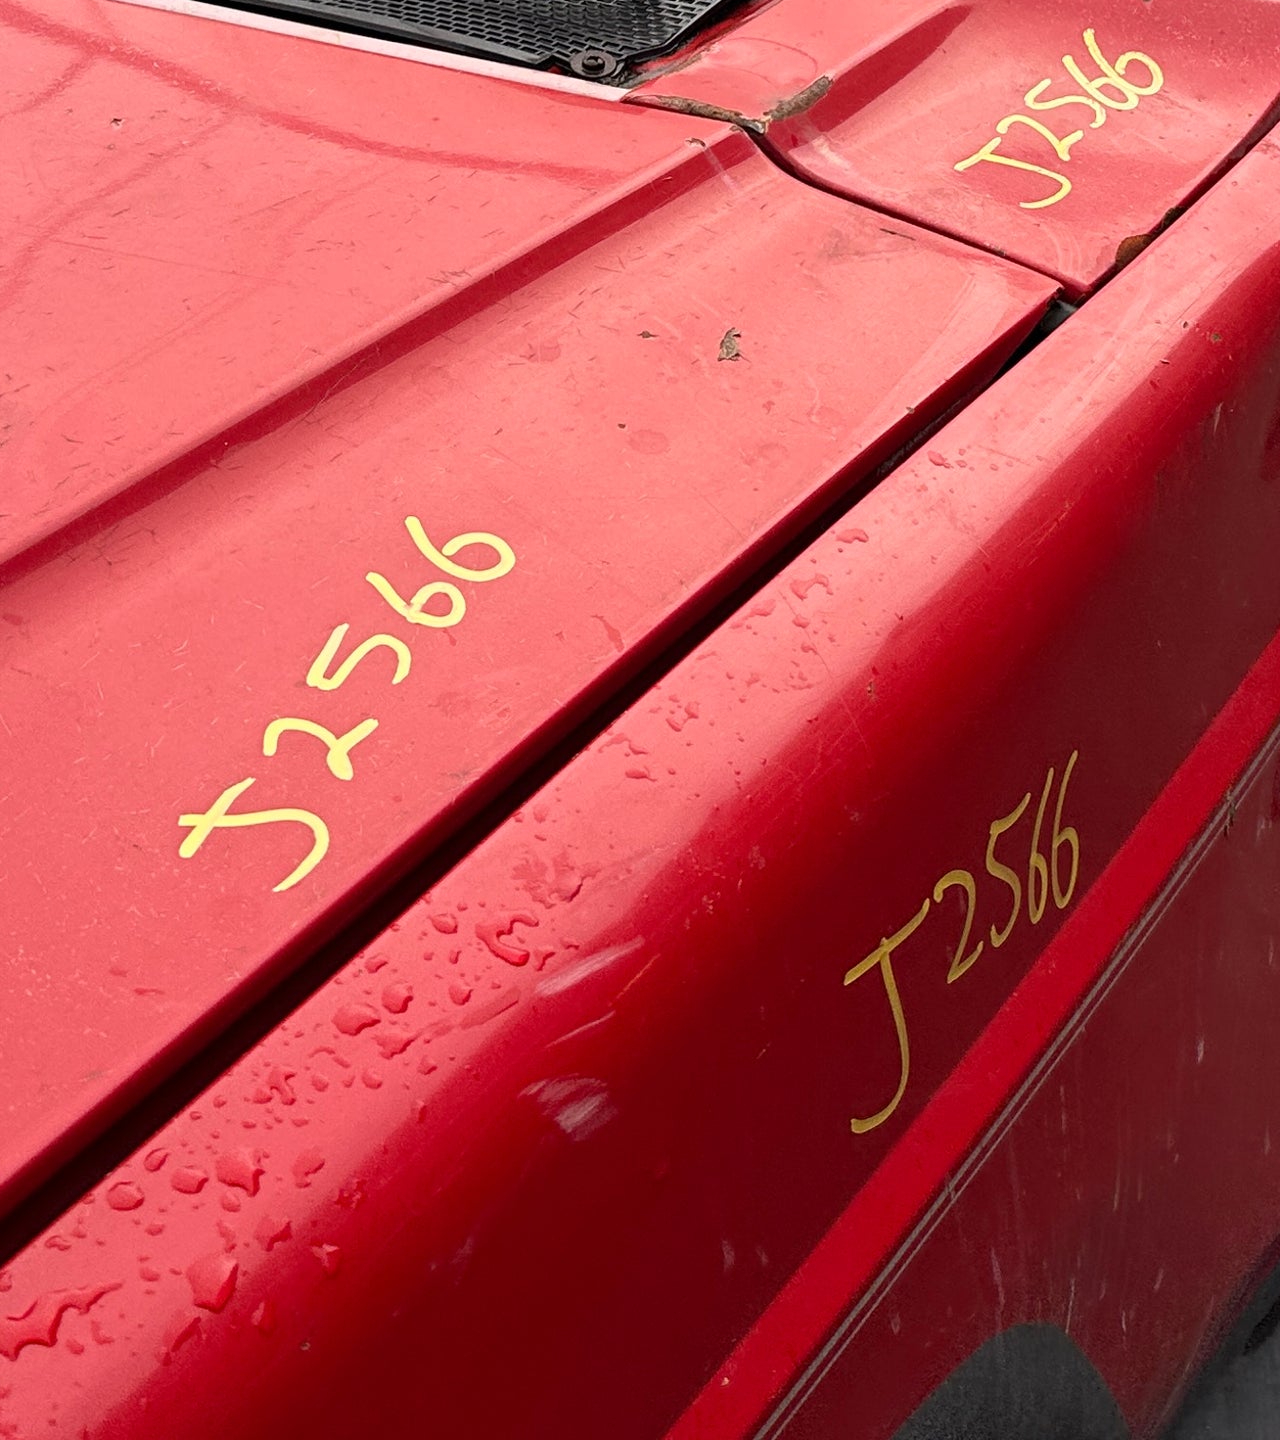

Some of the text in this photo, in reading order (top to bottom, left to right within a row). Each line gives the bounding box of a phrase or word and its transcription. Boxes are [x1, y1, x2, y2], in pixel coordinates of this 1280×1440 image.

[953, 27, 1164, 209] J2566
[177, 515, 516, 893] J2566
[843, 749, 1079, 1135] J2566
